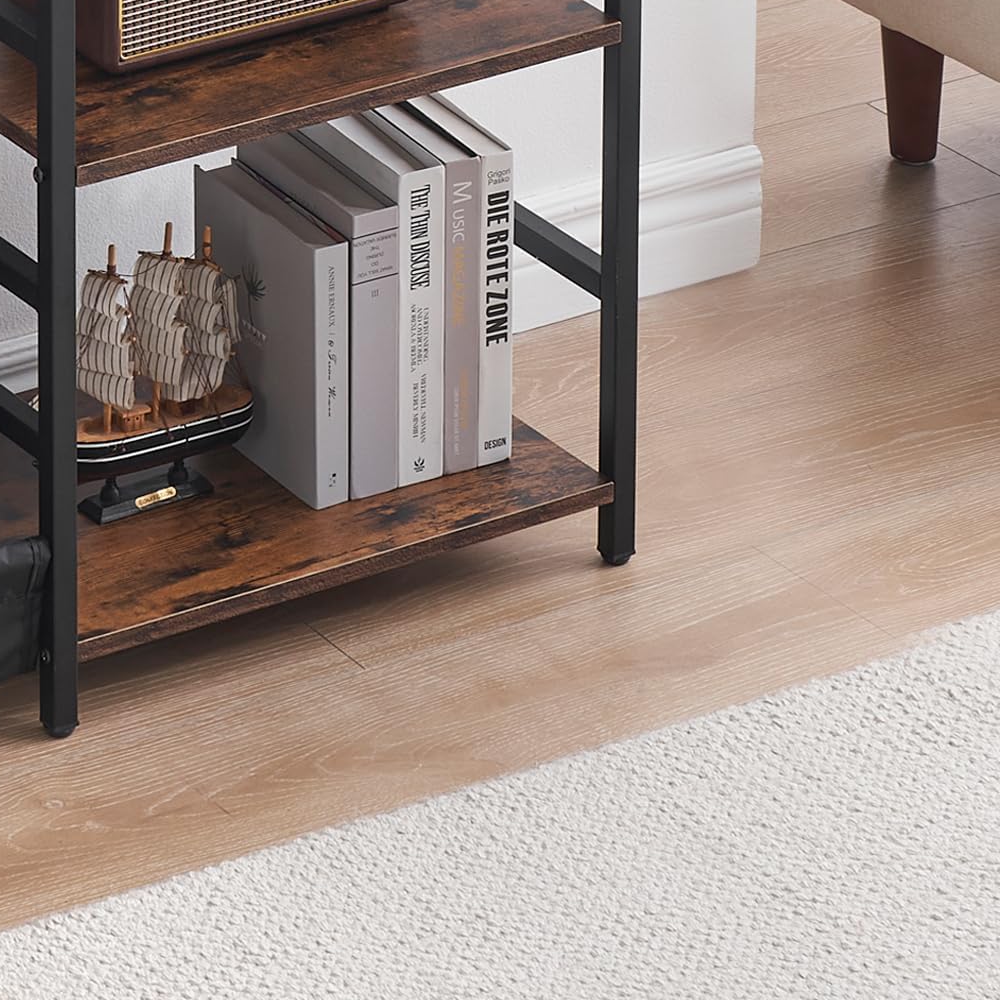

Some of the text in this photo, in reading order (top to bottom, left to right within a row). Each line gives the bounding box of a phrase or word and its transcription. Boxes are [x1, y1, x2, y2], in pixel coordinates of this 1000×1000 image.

[410, 184, 431, 210] THE
[410, 210, 431, 240] THIN
[486, 190, 509, 347] DIE ROTE ZONE
[484, 437, 507, 450] DESIGN
